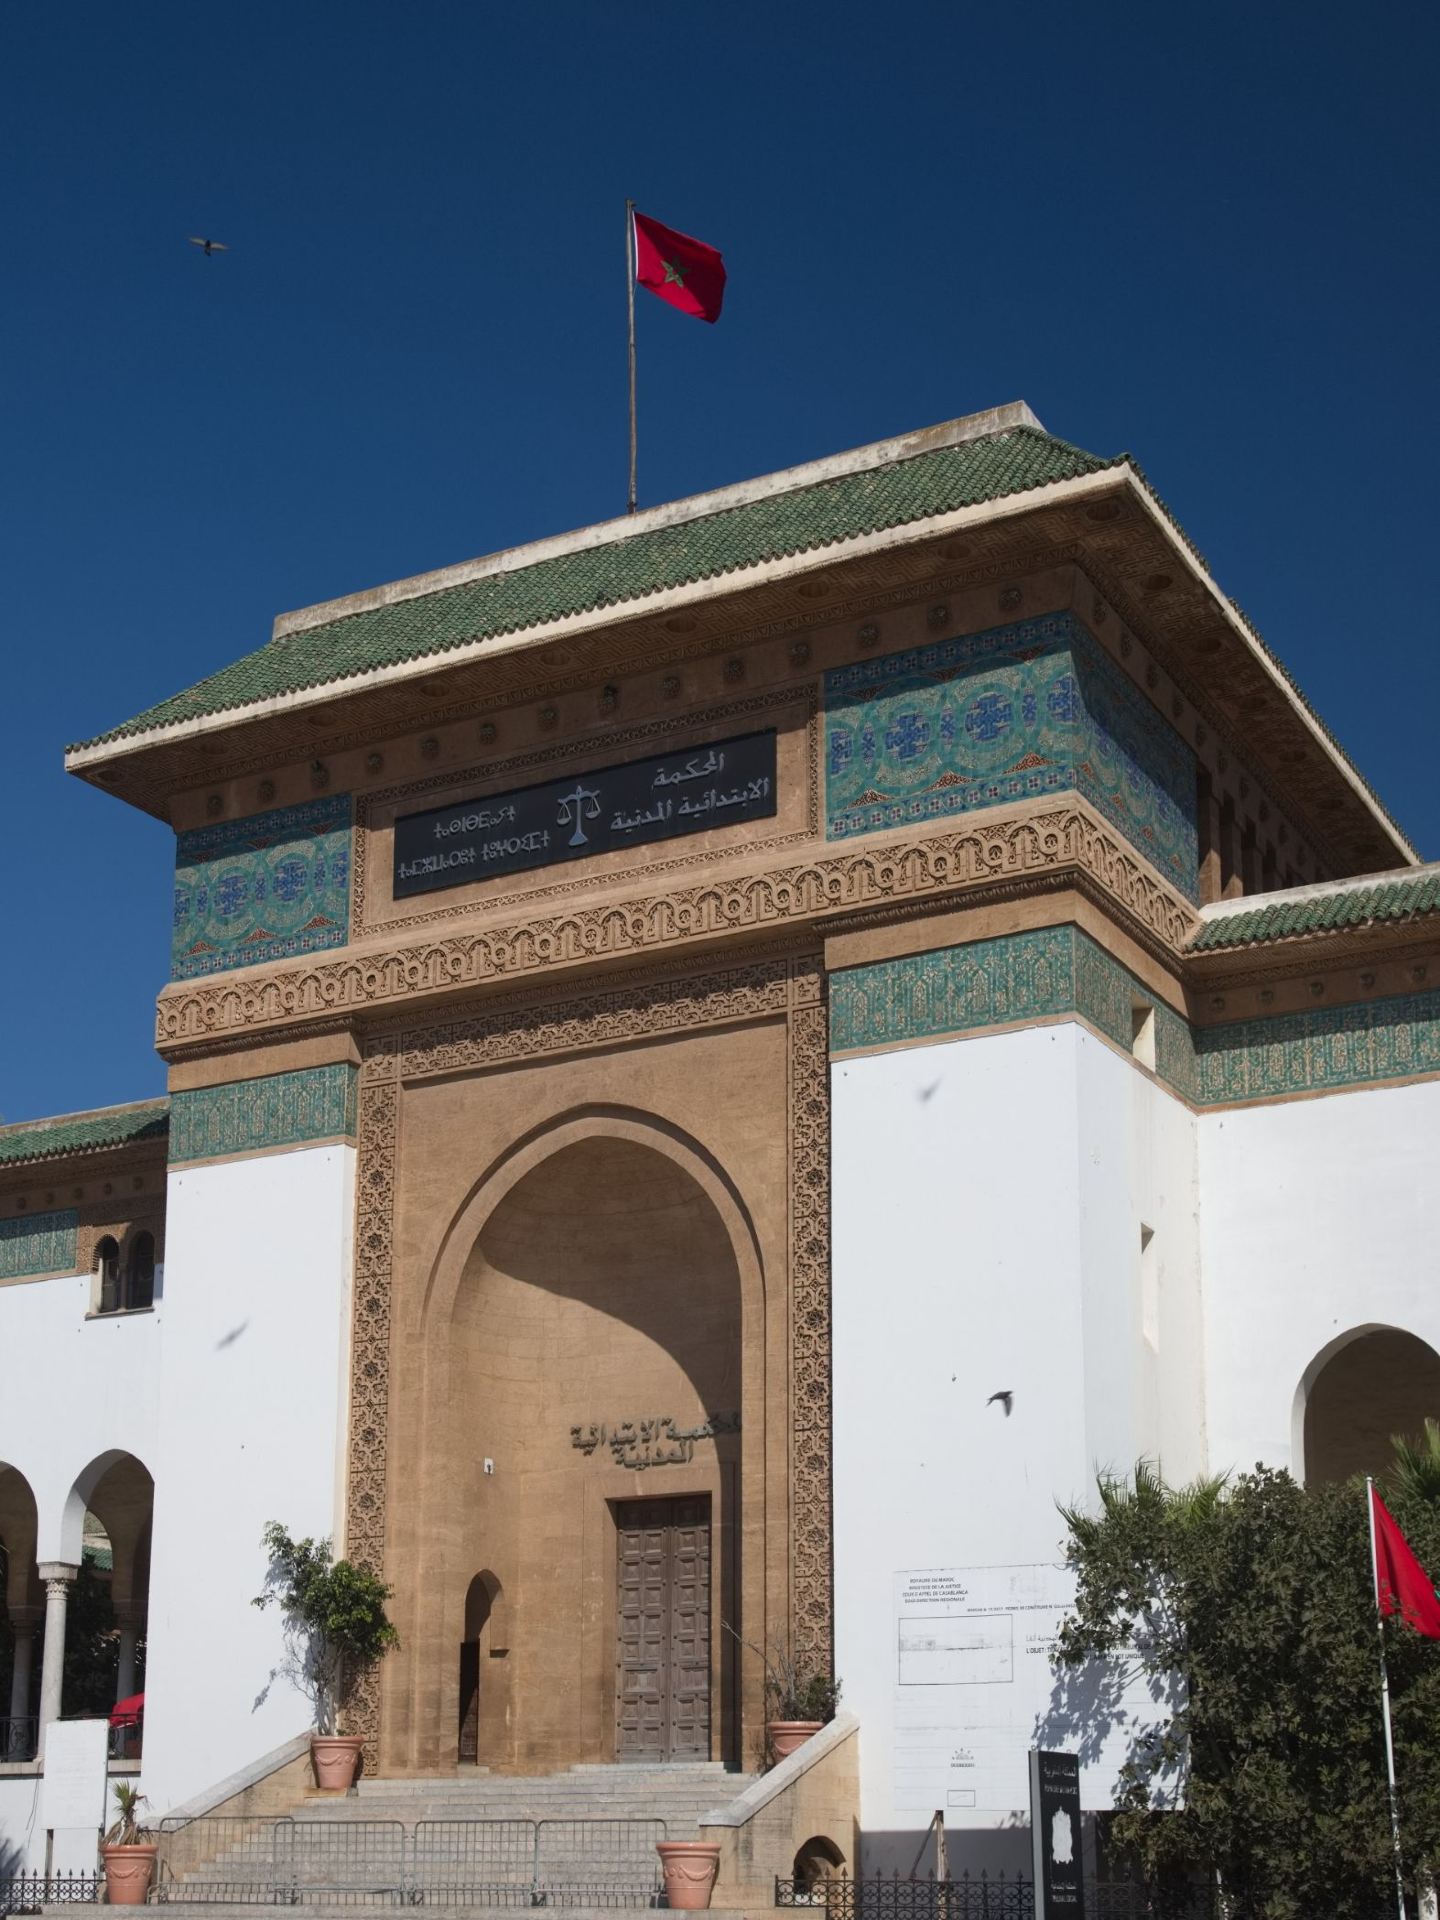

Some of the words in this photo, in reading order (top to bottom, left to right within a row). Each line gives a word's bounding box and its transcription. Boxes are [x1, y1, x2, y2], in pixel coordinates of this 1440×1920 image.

[651, 750, 726, 790] المحكمة
[610, 799, 672, 832] المدنية
[678, 777, 769, 818] الابتدائية
[611, 1440, 694, 1471] المدنية
